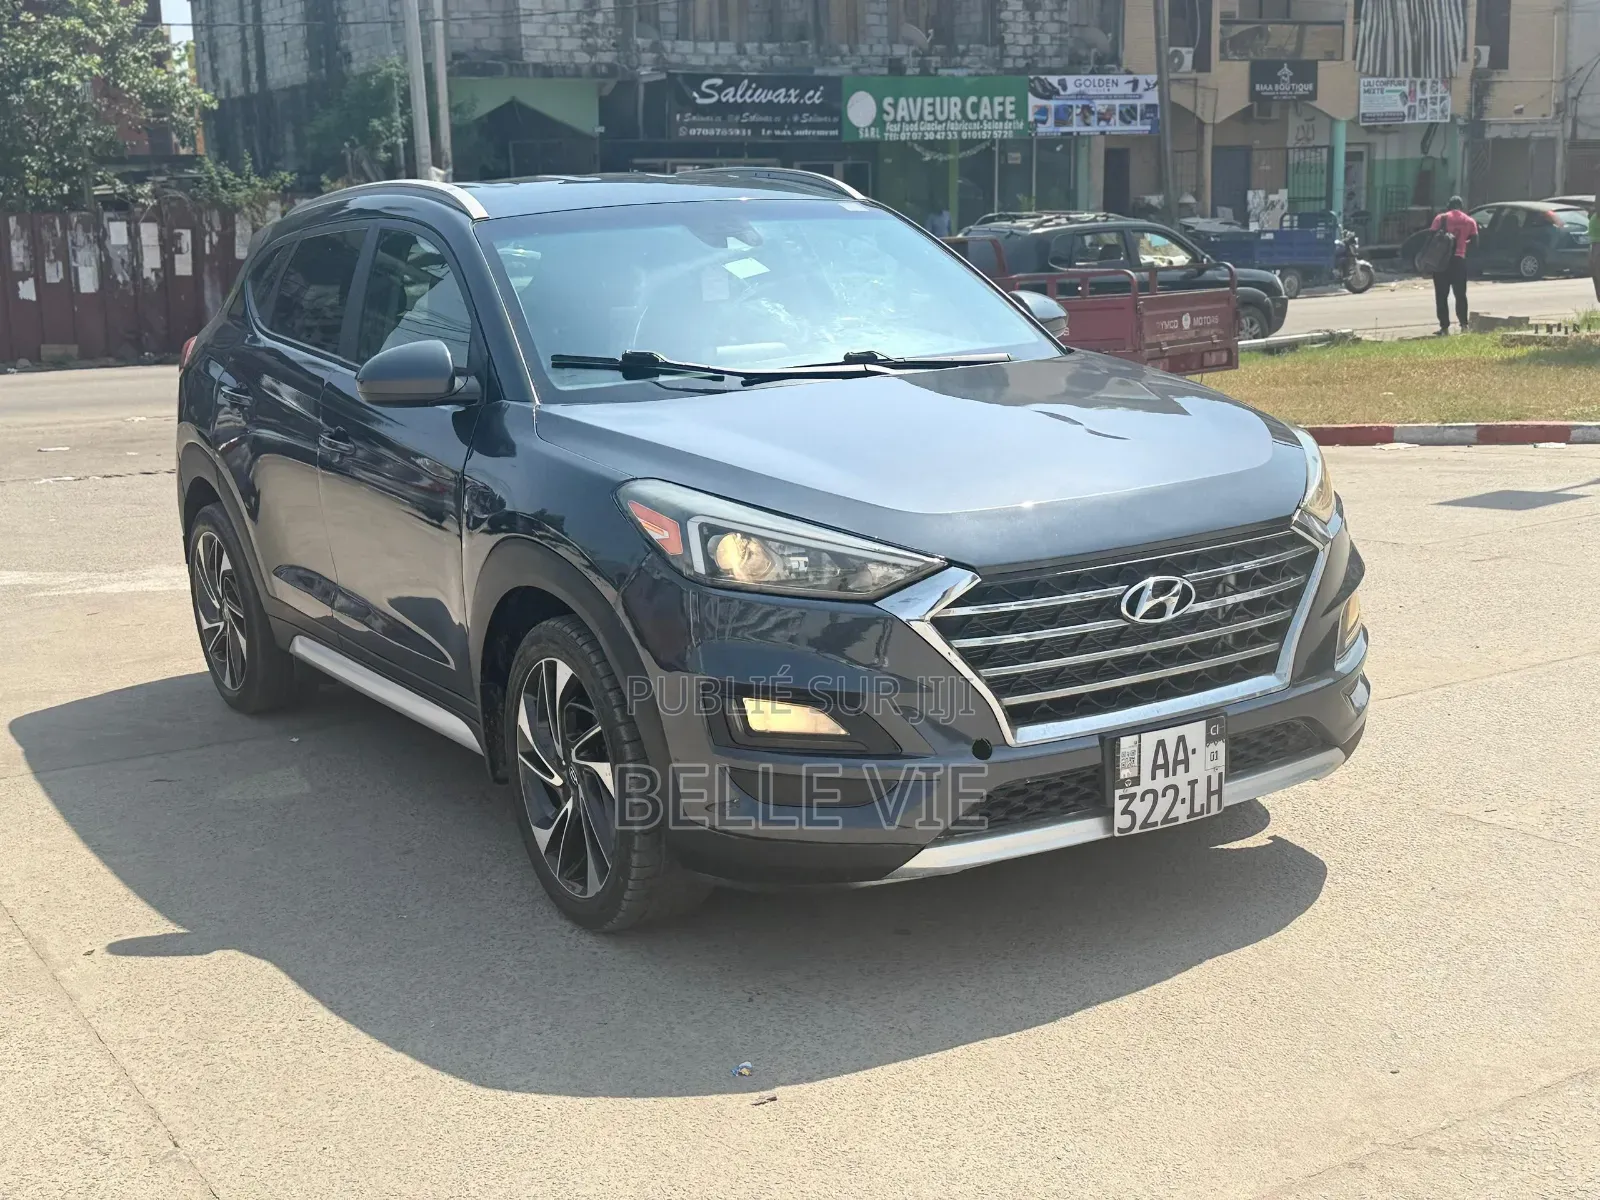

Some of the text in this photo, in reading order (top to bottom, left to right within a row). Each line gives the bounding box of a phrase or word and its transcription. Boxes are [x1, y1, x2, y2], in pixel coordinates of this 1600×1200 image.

[1074, 78, 1119, 88] GOLDEN
[1274, 83, 1314, 92] BOUTIQUE
[693, 78, 824, 104] Saliwax.ci
[883, 97, 963, 121] SAVEUR
[858, 127, 880, 139] SARL
